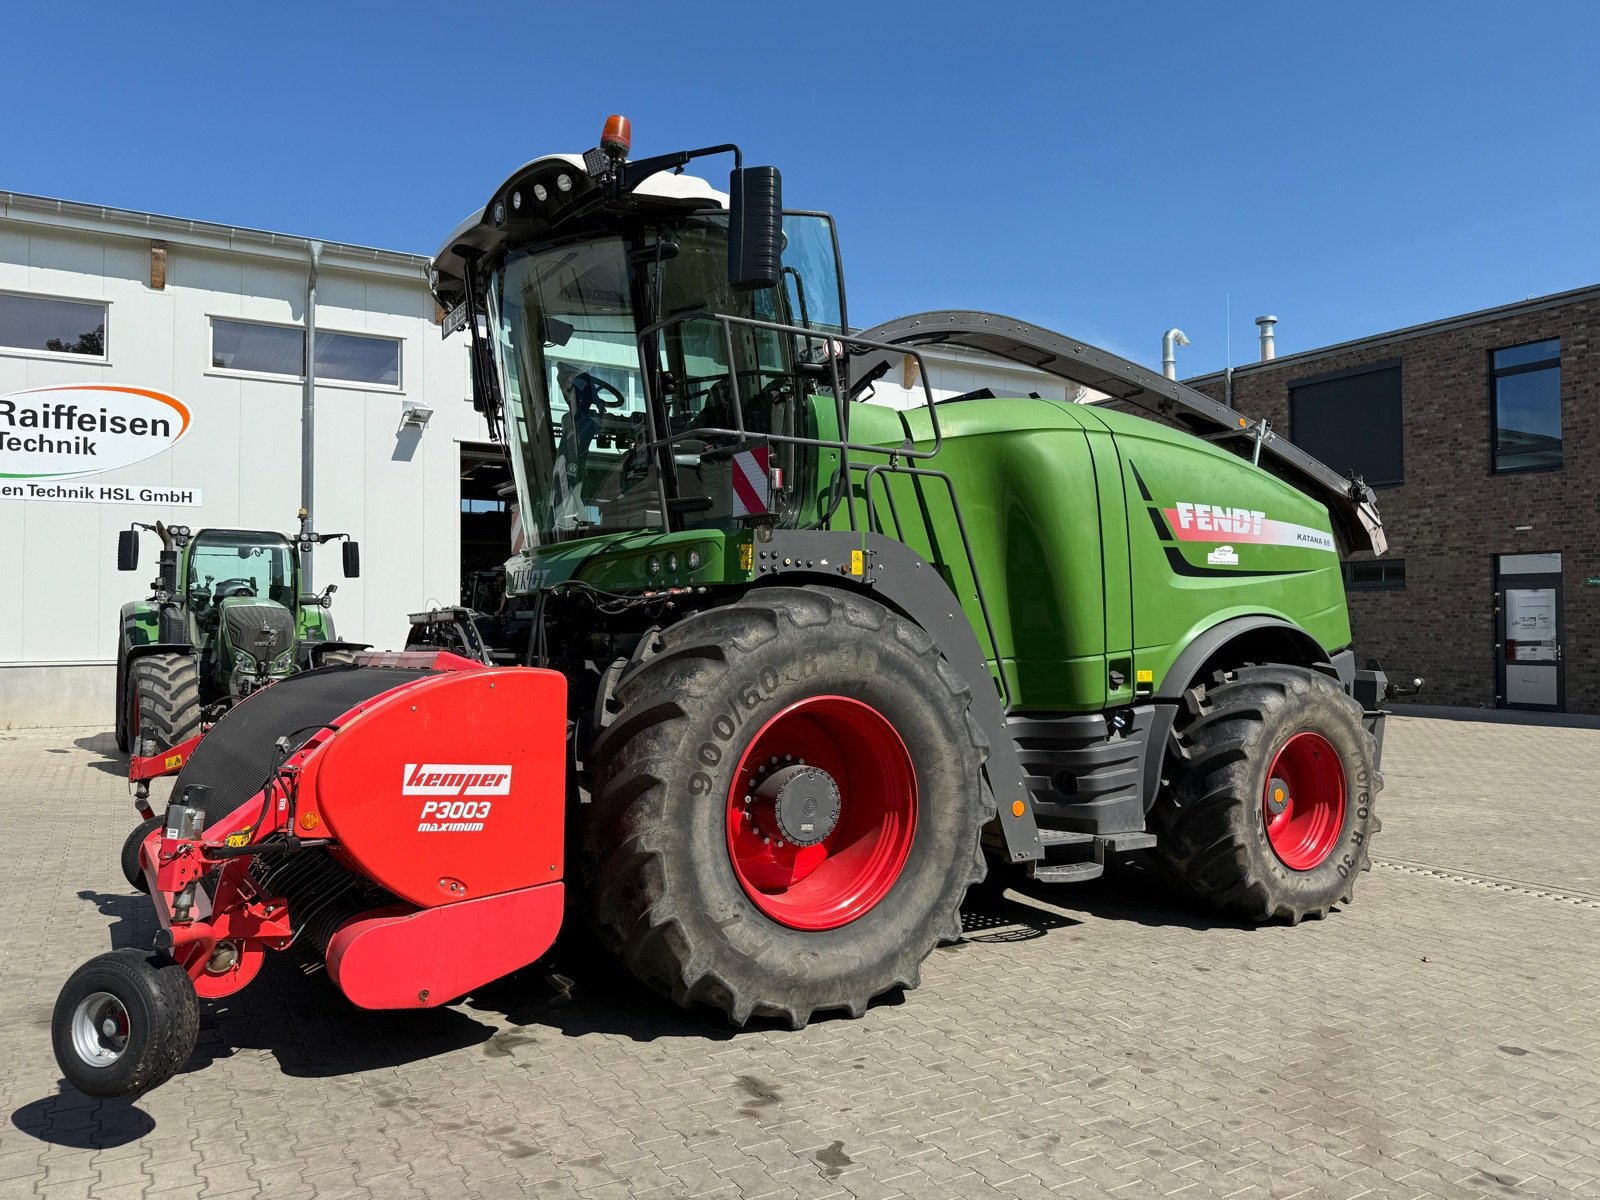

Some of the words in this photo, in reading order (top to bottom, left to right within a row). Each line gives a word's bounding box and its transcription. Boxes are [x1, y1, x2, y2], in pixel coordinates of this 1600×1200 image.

[0, 399, 170, 437] Raiffeisen
[0, 431, 97, 456] Technik
[0, 485, 24, 497] en
[27, 484, 95, 500] Technik
[100, 487, 135, 501] HSL
[139, 489, 193, 503] GmbH
[1176, 501, 1266, 536] FENDT
[1297, 532, 1322, 545] KATANA
[1323, 538, 1331, 547] 65
[687, 664, 781, 796] 900/60
[405, 763, 508, 796] kemper
[420, 801, 492, 819] P3003
[1350, 830, 1365, 847] R
[1337, 853, 1355, 880] 30
